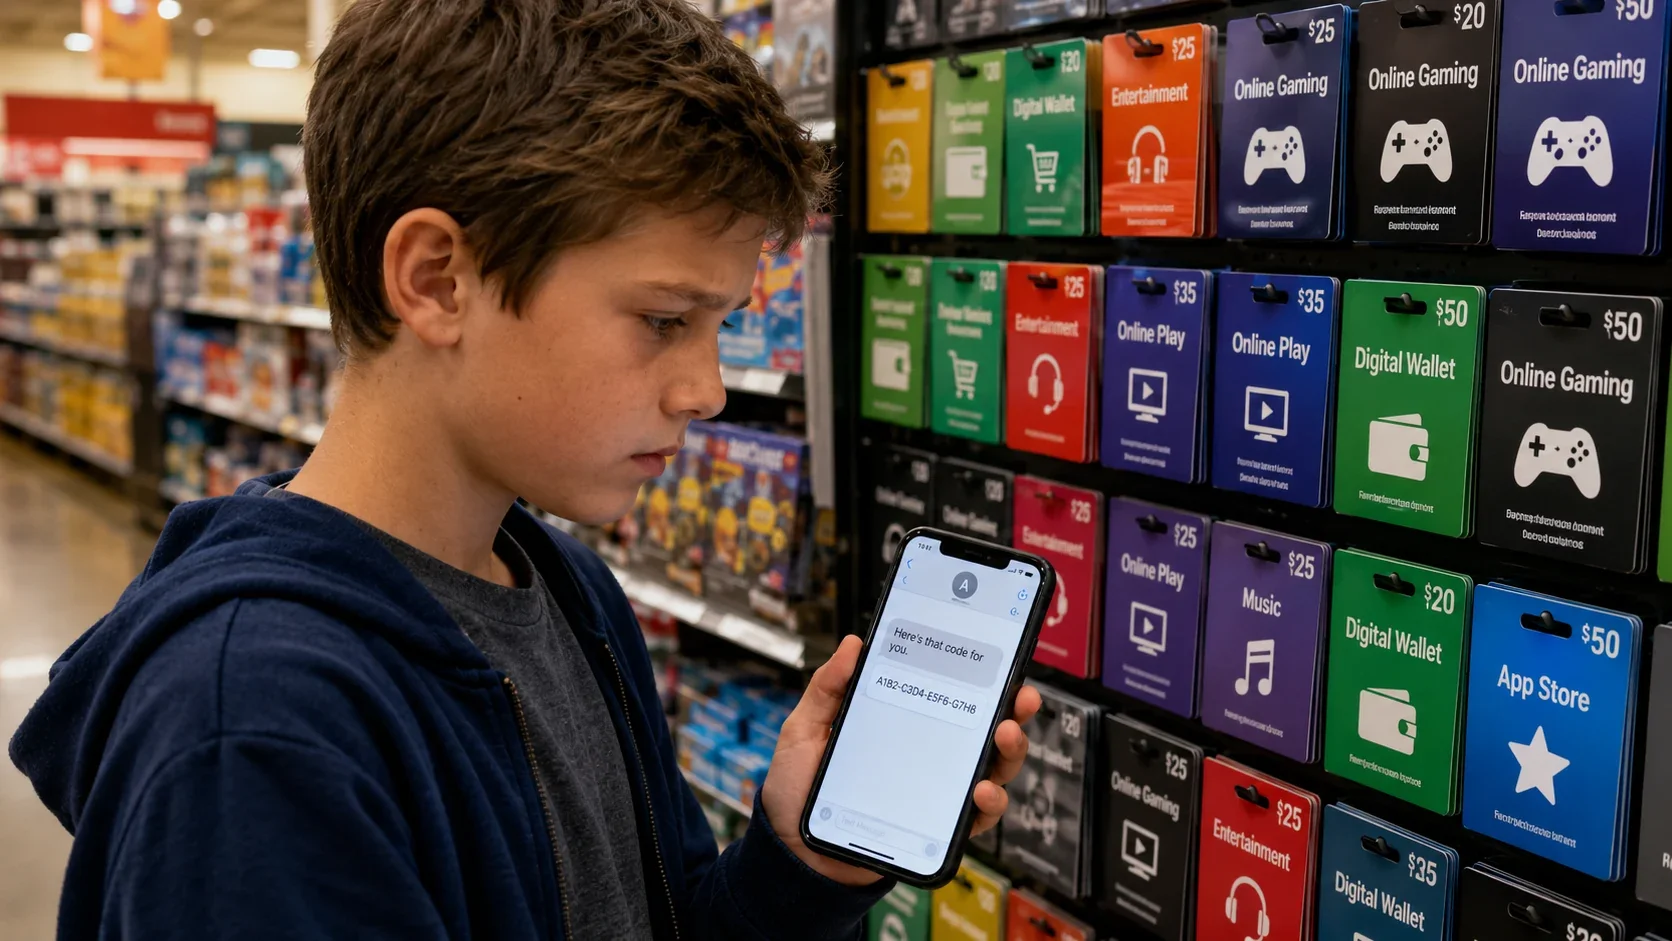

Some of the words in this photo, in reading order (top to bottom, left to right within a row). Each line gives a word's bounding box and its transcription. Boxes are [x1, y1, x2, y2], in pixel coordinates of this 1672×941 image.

[1454, 2, 1485, 30] $20
[1616, 0, 1654, 21] $50
[1308, 18, 1335, 44] $25
[1061, 50, 1080, 74] $20
[1172, 36, 1195, 62] $25
[1368, 66, 1415, 91] Online
[1419, 61, 1479, 89] Gaming
[1513, 57, 1568, 84] Online
[1573, 52, 1646, 85] Gaming
[1111, 82, 1189, 107] Entertainment
[1234, 78, 1275, 101] Online
[1276, 72, 1328, 98] Gaming
[1013, 98, 1043, 120] Digital
[1044, 94, 1075, 114] Wallet
[1063, 275, 1085, 299] $25
[1174, 279, 1197, 305] $35
[1298, 288, 1325, 314] $35
[1015, 313, 1079, 338] Entertainment
[1436, 297, 1469, 328] $50
[1603, 309, 1643, 342] $50
[1117, 320, 1155, 344] Online
[1157, 323, 1186, 352] Play
[1232, 331, 1275, 357] Online
[1279, 335, 1311, 366] Play
[1354, 346, 1403, 377] Digital
[1406, 351, 1456, 380] Wallet
[1500, 360, 1556, 390] Online
[1560, 365, 1634, 404] Gaming
[1174, 522, 1197, 549] $25
[1120, 552, 1156, 580] Online
[1157, 560, 1185, 592] Play
[1288, 550, 1315, 580] $25
[958, 579, 969, 593] A
[1424, 582, 1455, 615] $20
[1242, 586, 1281, 618] Music
[888, 642, 908, 657] you.
[894, 626, 923, 645] Here's
[924, 634, 944, 651] that
[944, 641, 969, 659] code
[969, 649, 985, 663] for
[1345, 616, 1391, 650] Digital
[1395, 629, 1443, 665] Wallet
[1581, 622, 1620, 659] $50
[1497, 664, 1534, 699] App
[1538, 675, 1591, 712] Store
[1165, 751, 1187, 781] $25
[1111, 770, 1142, 801] Online
[1142, 785, 1180, 823] Gaming
[1276, 798, 1302, 832] $25
[1213, 817, 1291, 872] Entertainment
[1408, 851, 1437, 887] $35
[1335, 870, 1378, 910] Digital
[1381, 891, 1425, 933] Wallet
